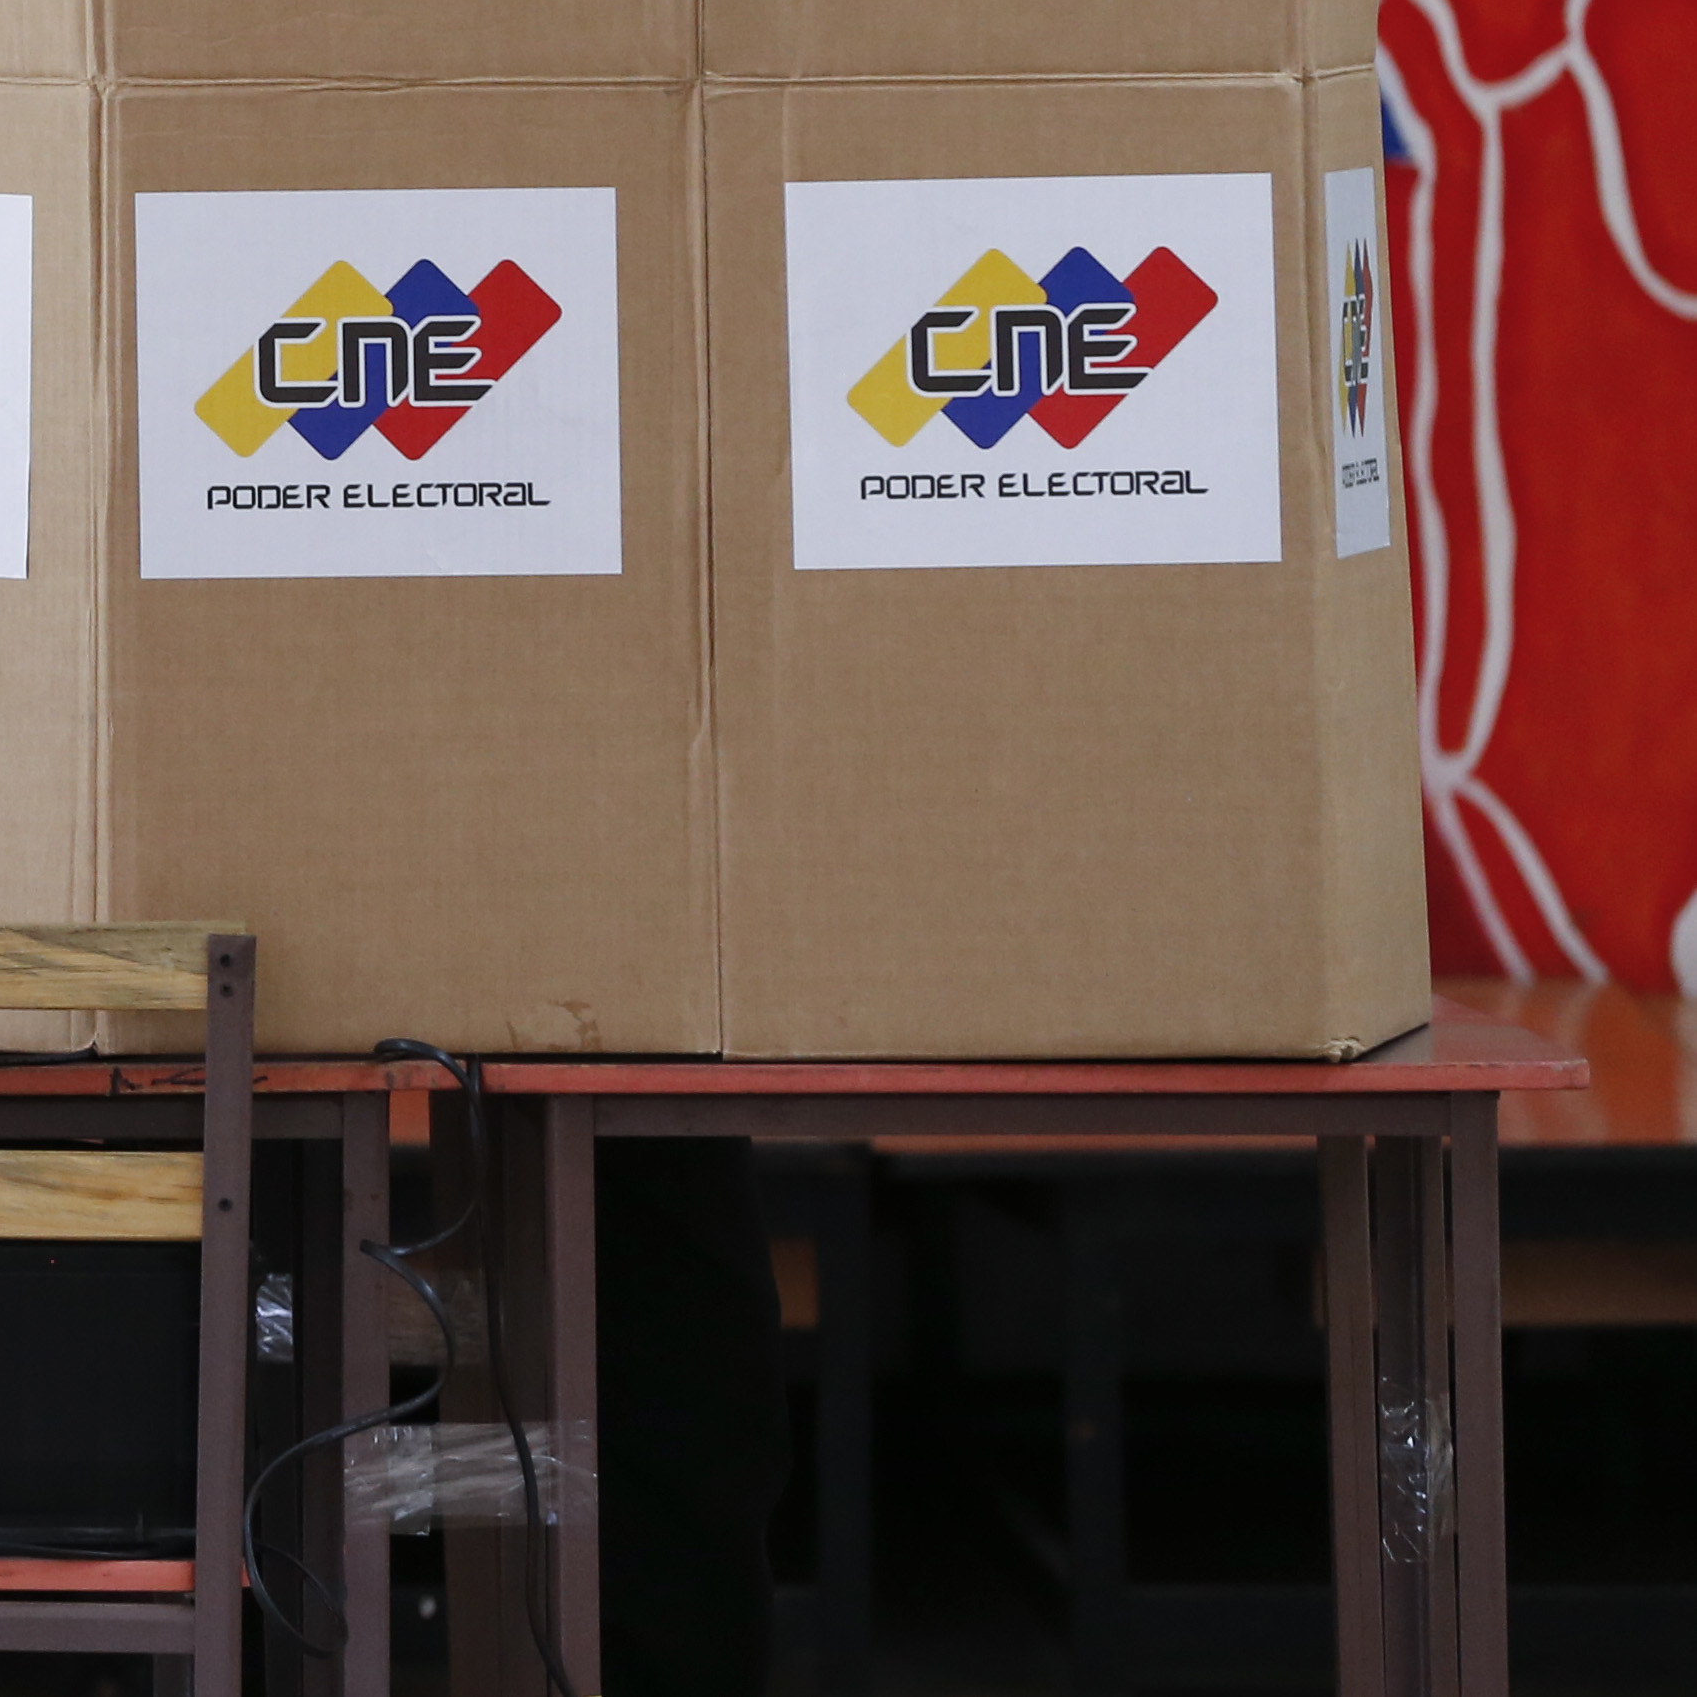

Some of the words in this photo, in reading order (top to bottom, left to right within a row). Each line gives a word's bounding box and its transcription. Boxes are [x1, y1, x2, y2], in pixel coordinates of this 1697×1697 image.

[258, 321, 495, 403] CNE
[910, 307, 1150, 393] CNE
[207, 484, 331, 510] PODER
[343, 481, 552, 509] ELECTORAL
[860, 473, 986, 500] PODER
[998, 469, 1210, 498] ELECTORAL
